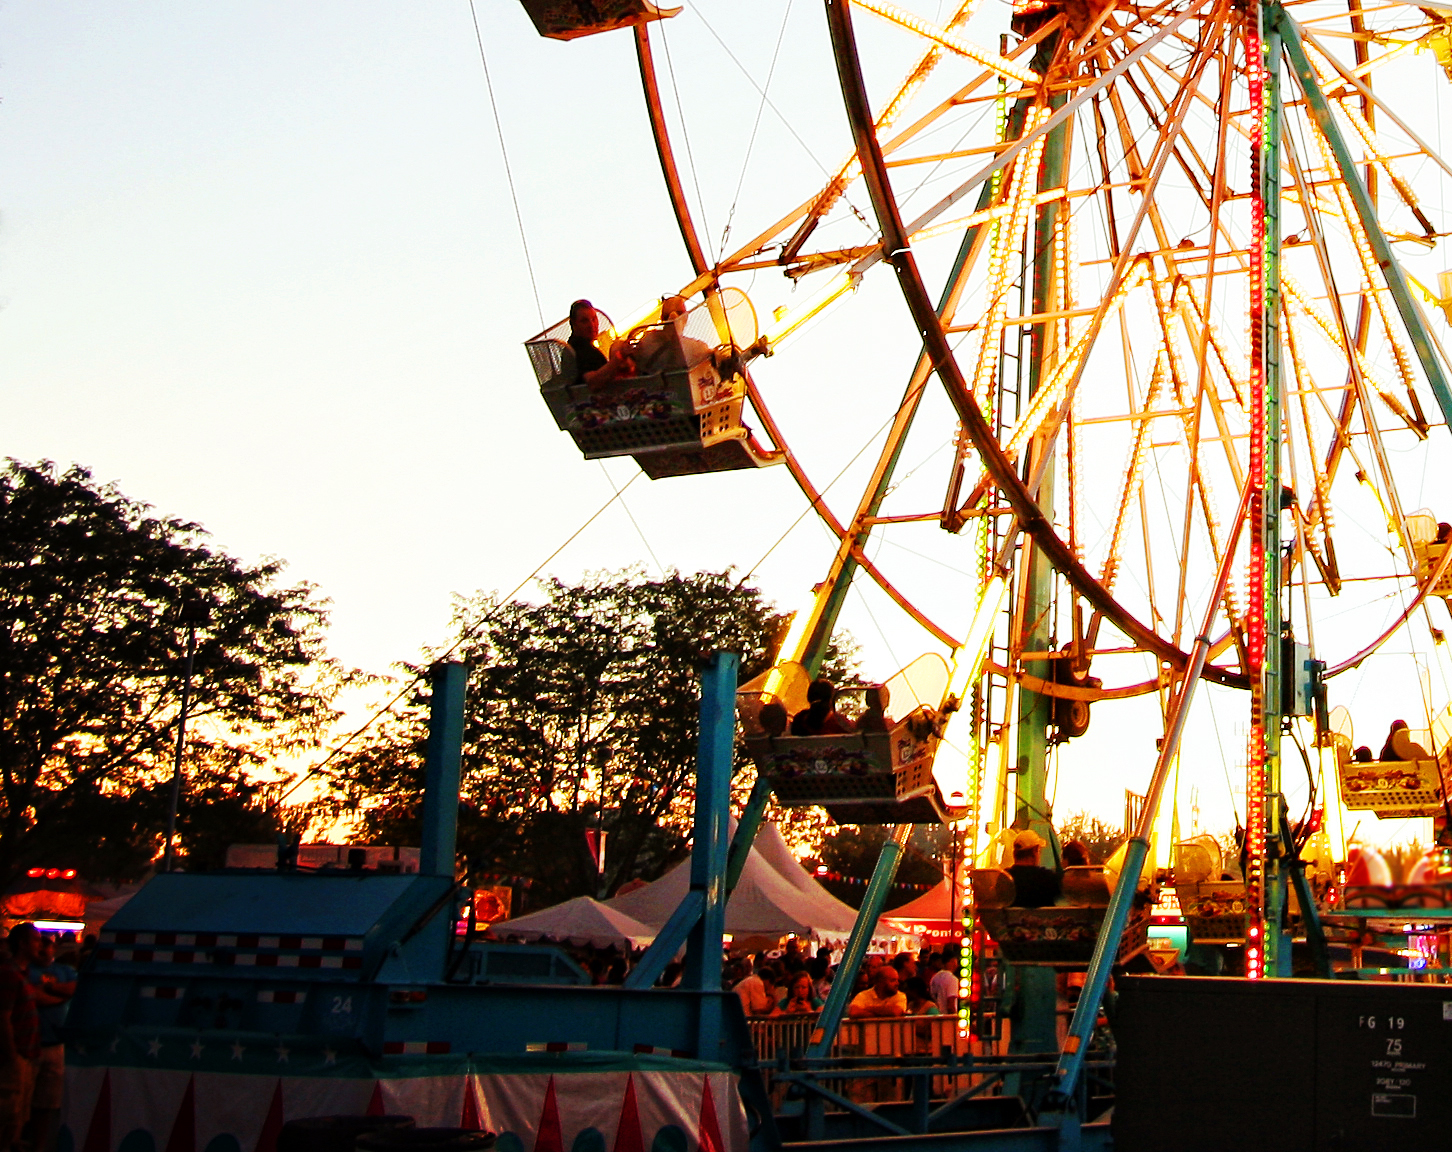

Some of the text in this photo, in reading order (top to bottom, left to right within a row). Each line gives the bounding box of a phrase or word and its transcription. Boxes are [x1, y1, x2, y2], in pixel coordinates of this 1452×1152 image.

[332, 995, 352, 1014] 24
[1358, 1016, 1405, 1029] FG 19
[1386, 1038, 1402, 1051] 75
